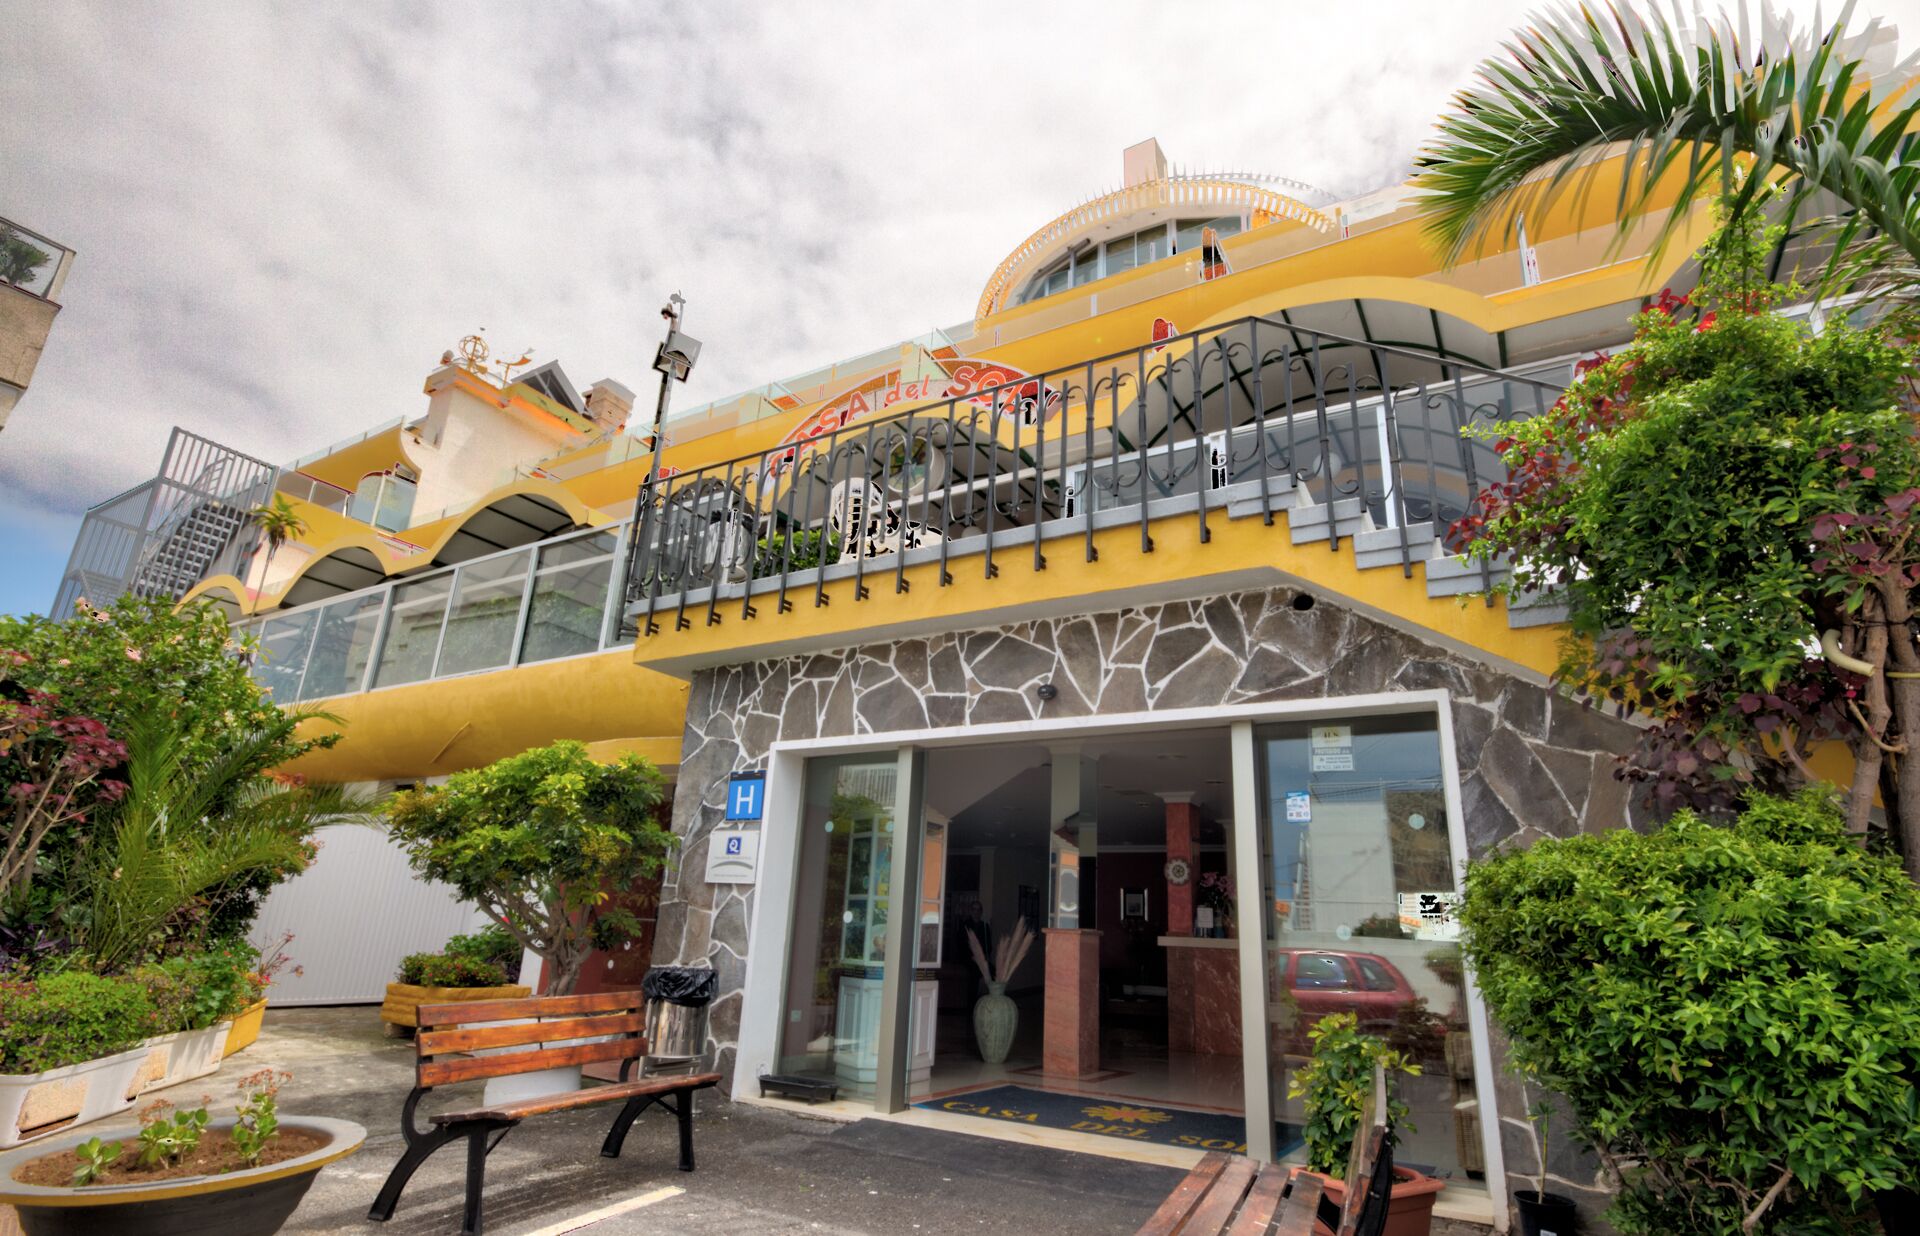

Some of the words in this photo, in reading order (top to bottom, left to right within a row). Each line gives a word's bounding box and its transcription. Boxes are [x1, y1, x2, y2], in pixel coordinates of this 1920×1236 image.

[885, 374, 930, 405] del
[735, 784, 755, 815] H
[729, 839, 739, 853] Q
[943, 1101, 1039, 1122] CASA
[1070, 1120, 1150, 1140] DEL
